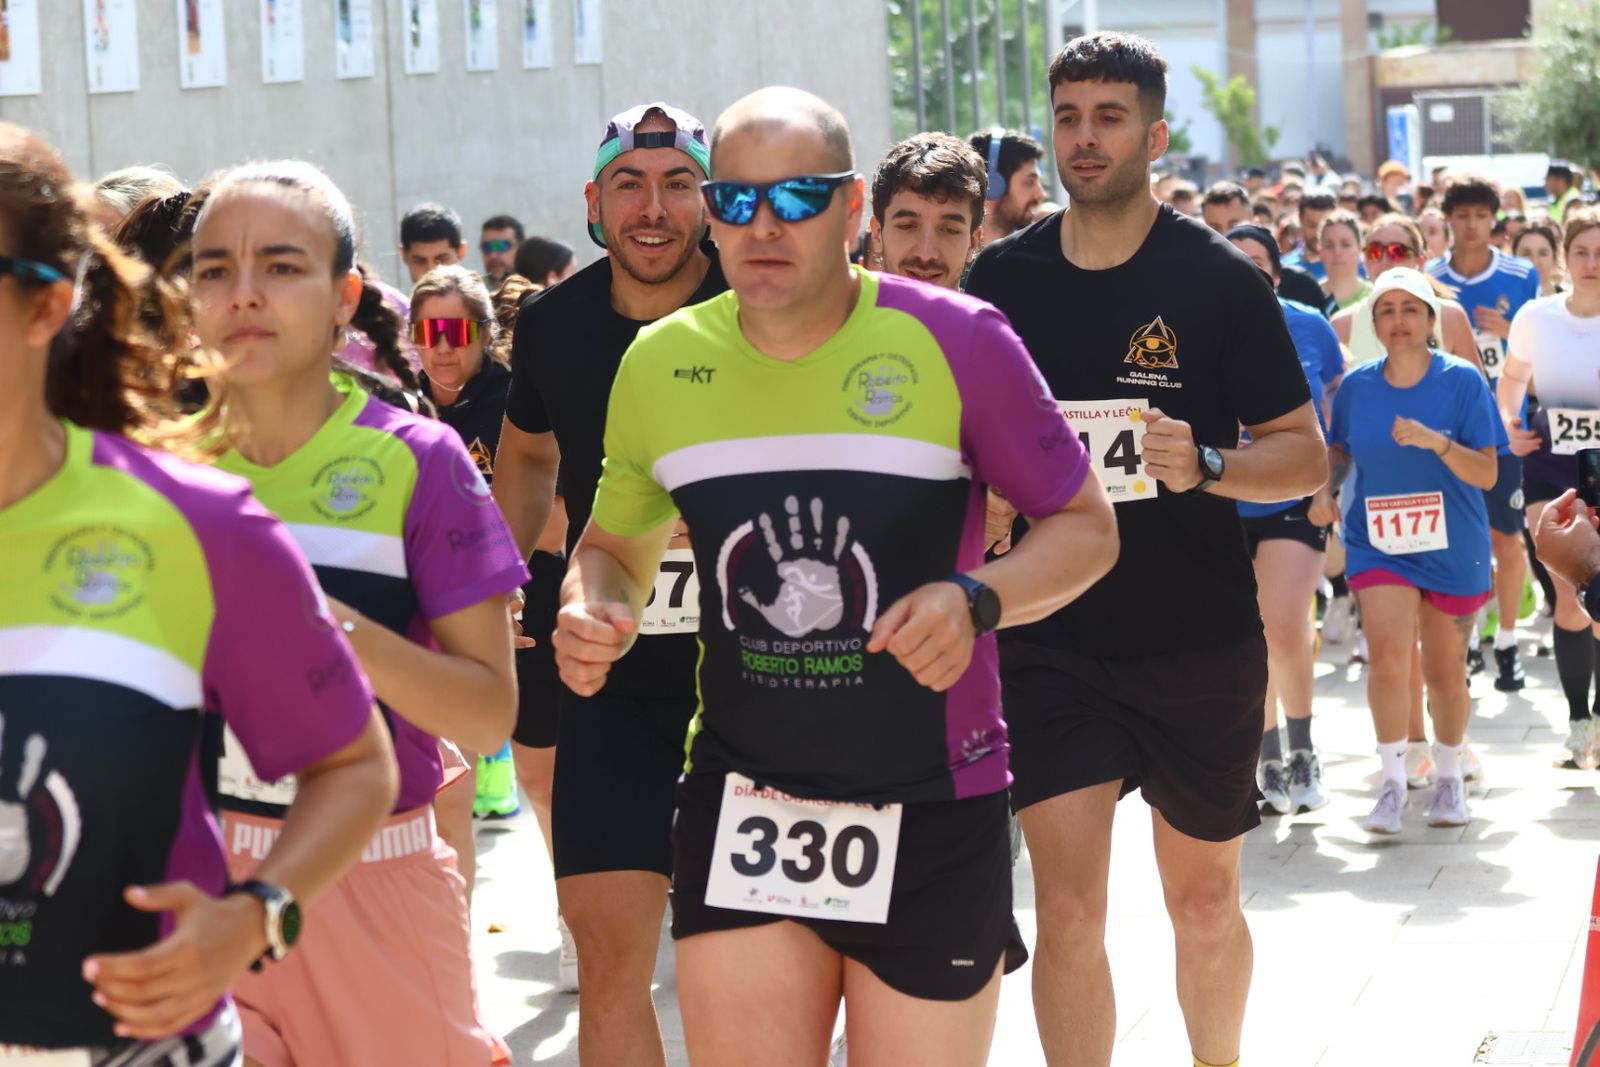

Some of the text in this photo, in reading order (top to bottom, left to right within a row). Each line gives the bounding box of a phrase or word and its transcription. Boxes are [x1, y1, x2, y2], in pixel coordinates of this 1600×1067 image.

[1116, 376, 1182, 389] RUNNING CLUB
[1129, 371, 1168, 381] GALENA
[1063, 410, 1101, 419] ASTILLA
[1103, 410, 1110, 418] Y
[1373, 510, 1440, 538] 1177
[740, 635, 862, 654] CLUB DEPORTIVO
[742, 649, 864, 675] ROBERTO RAMOS
[730, 816, 880, 888] 330
